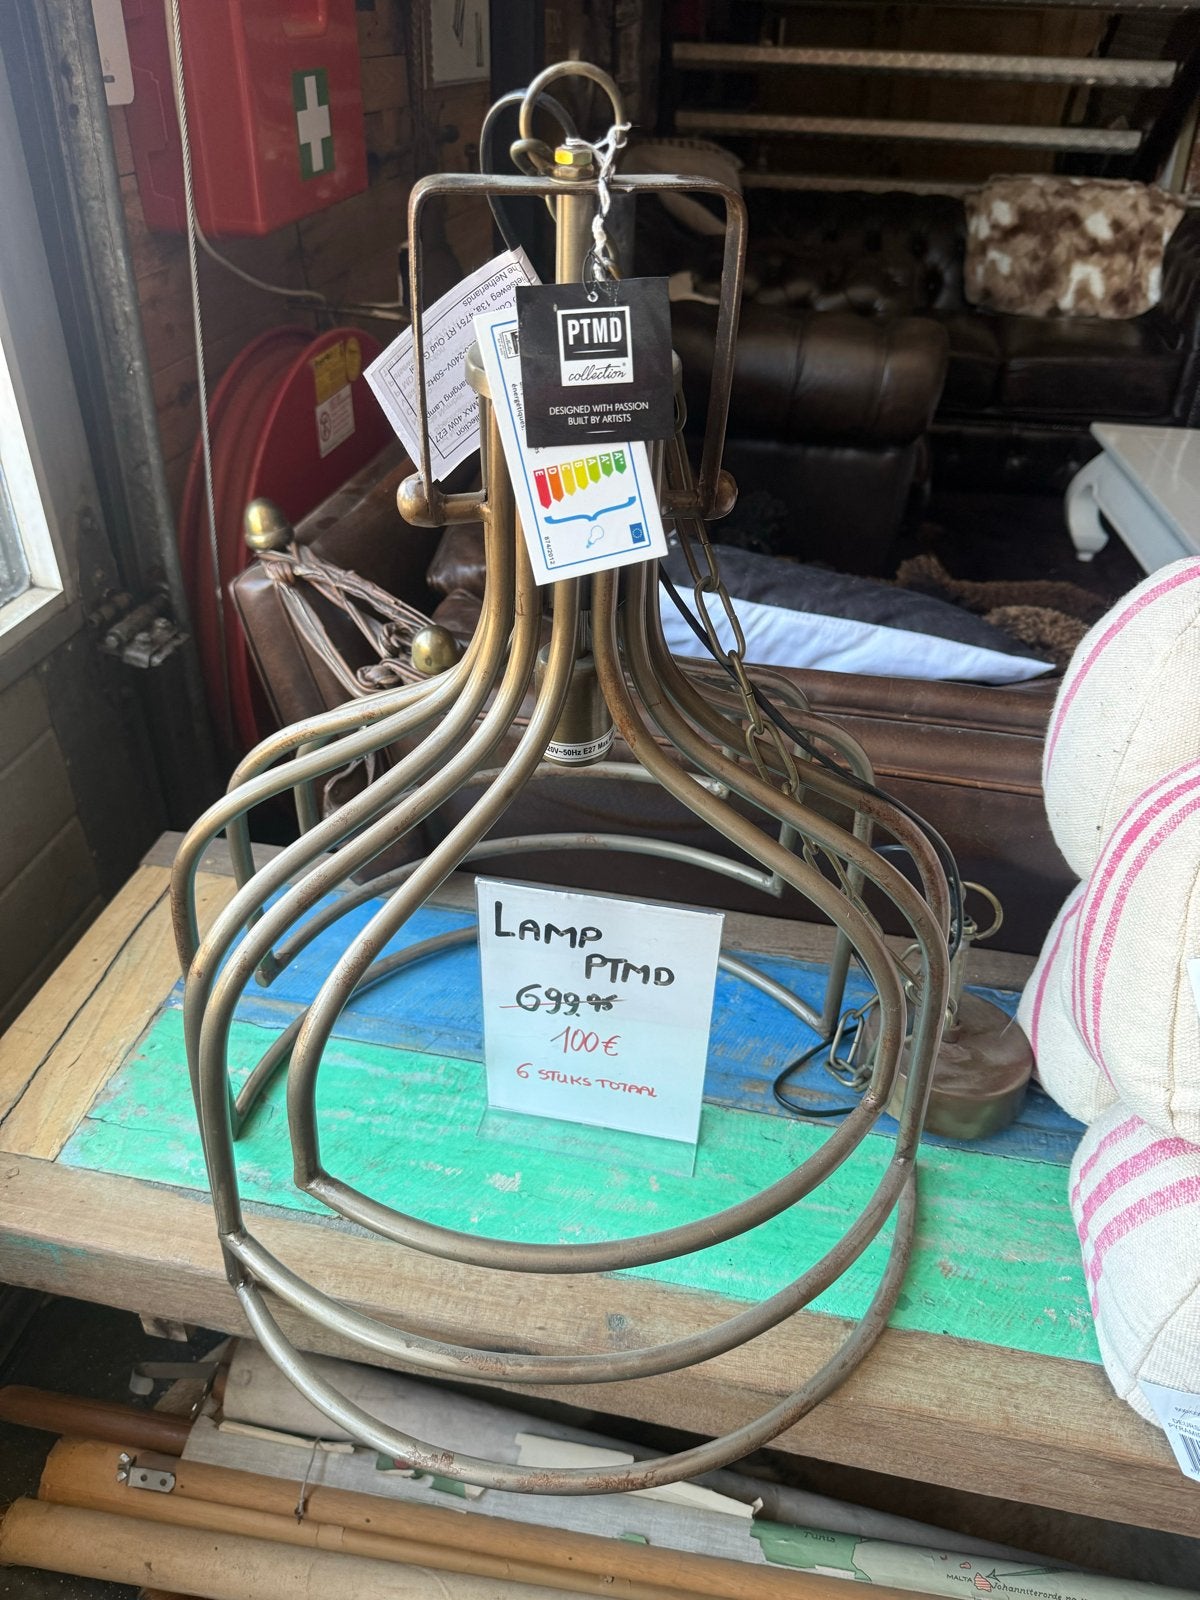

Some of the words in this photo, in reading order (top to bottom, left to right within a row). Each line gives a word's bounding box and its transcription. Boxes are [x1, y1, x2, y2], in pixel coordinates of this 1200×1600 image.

[462, 271, 508, 307] Netherlands
[456, 312, 474, 330] 4751
[445, 327, 457, 341] RT
[567, 317, 622, 345] PTMD
[430, 337, 446, 353] Oud
[568, 363, 626, 382] collection
[443, 380, 467, 402] anging
[549, 404, 591, 416] DESIGNED
[592, 403, 613, 413] WITH
[614, 401, 649, 412] PASSION
[456, 413, 480, 436] llection
[568, 416, 588, 425] BUILT
[590, 415, 601, 424] BY
[602, 413, 632, 423] ARTISTS
[547, 745, 582, 756] 20V~50Hz
[583, 746, 596, 755] E27
[494, 900, 603, 949] LAMP
[585, 953, 675, 986] PTMD
[516, 1062, 533, 1079] 6
[538, 1068, 592, 1087] STUKS
[595, 1078, 657, 1098] TOTAAL
[946, 1573, 973, 1583] MALTA
